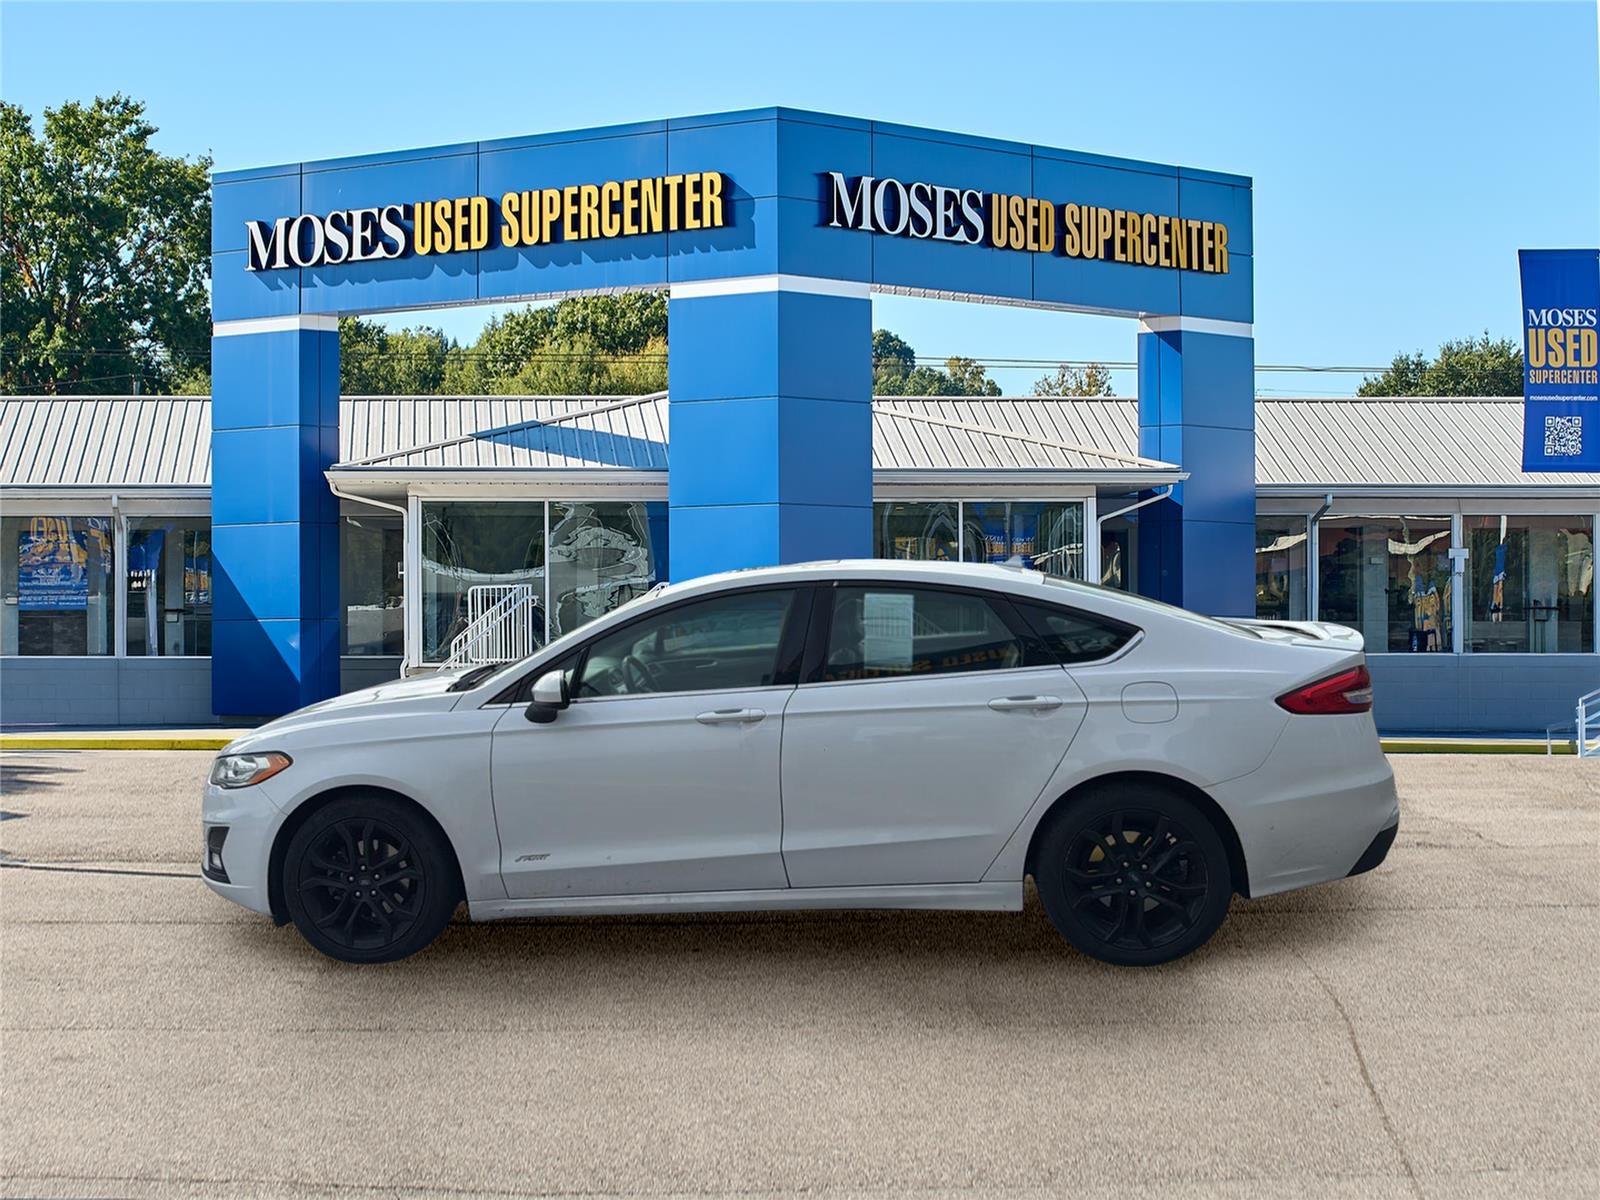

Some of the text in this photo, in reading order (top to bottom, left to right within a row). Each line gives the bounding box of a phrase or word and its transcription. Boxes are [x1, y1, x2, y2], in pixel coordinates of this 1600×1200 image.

[244, 171, 725, 272] MOSES USED SUPERCENTER
[828, 171, 1229, 274] MOSES USED SUPERCENTER
[1527, 308, 1597, 327] MOSES
[1528, 328, 1598, 368] USED
[1529, 369, 1598, 385] SUPERCENTER
